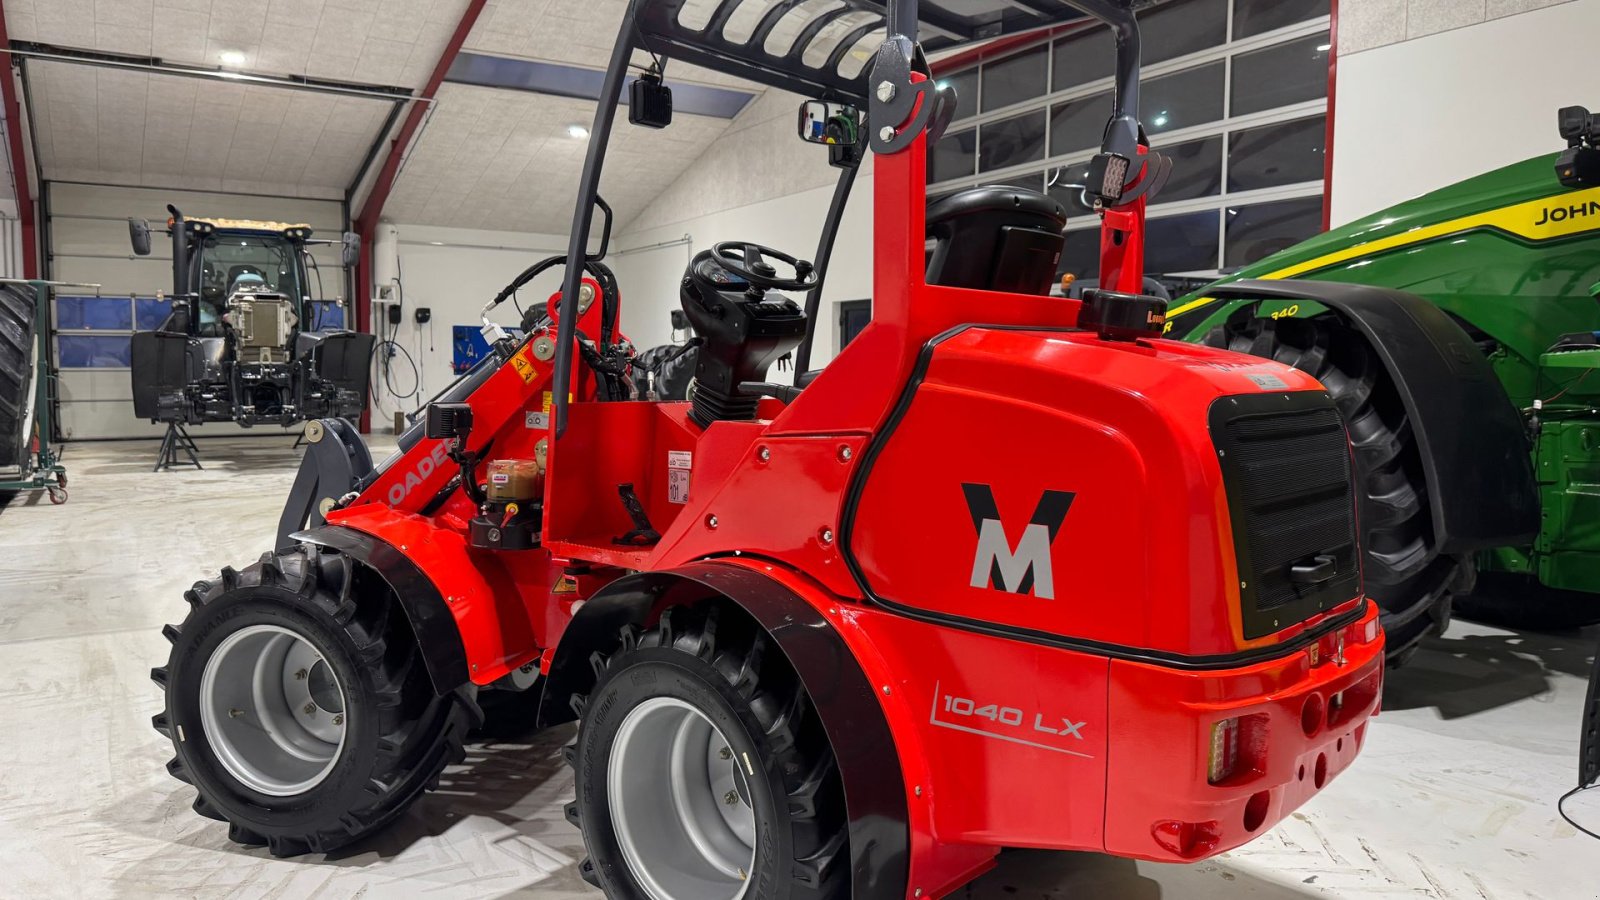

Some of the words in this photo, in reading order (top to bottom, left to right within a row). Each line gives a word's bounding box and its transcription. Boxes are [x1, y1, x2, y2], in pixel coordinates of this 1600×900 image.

[378, 436, 458, 508] OADER
[944, 694, 1023, 727] 1040
[1034, 713, 1088, 740] LX
